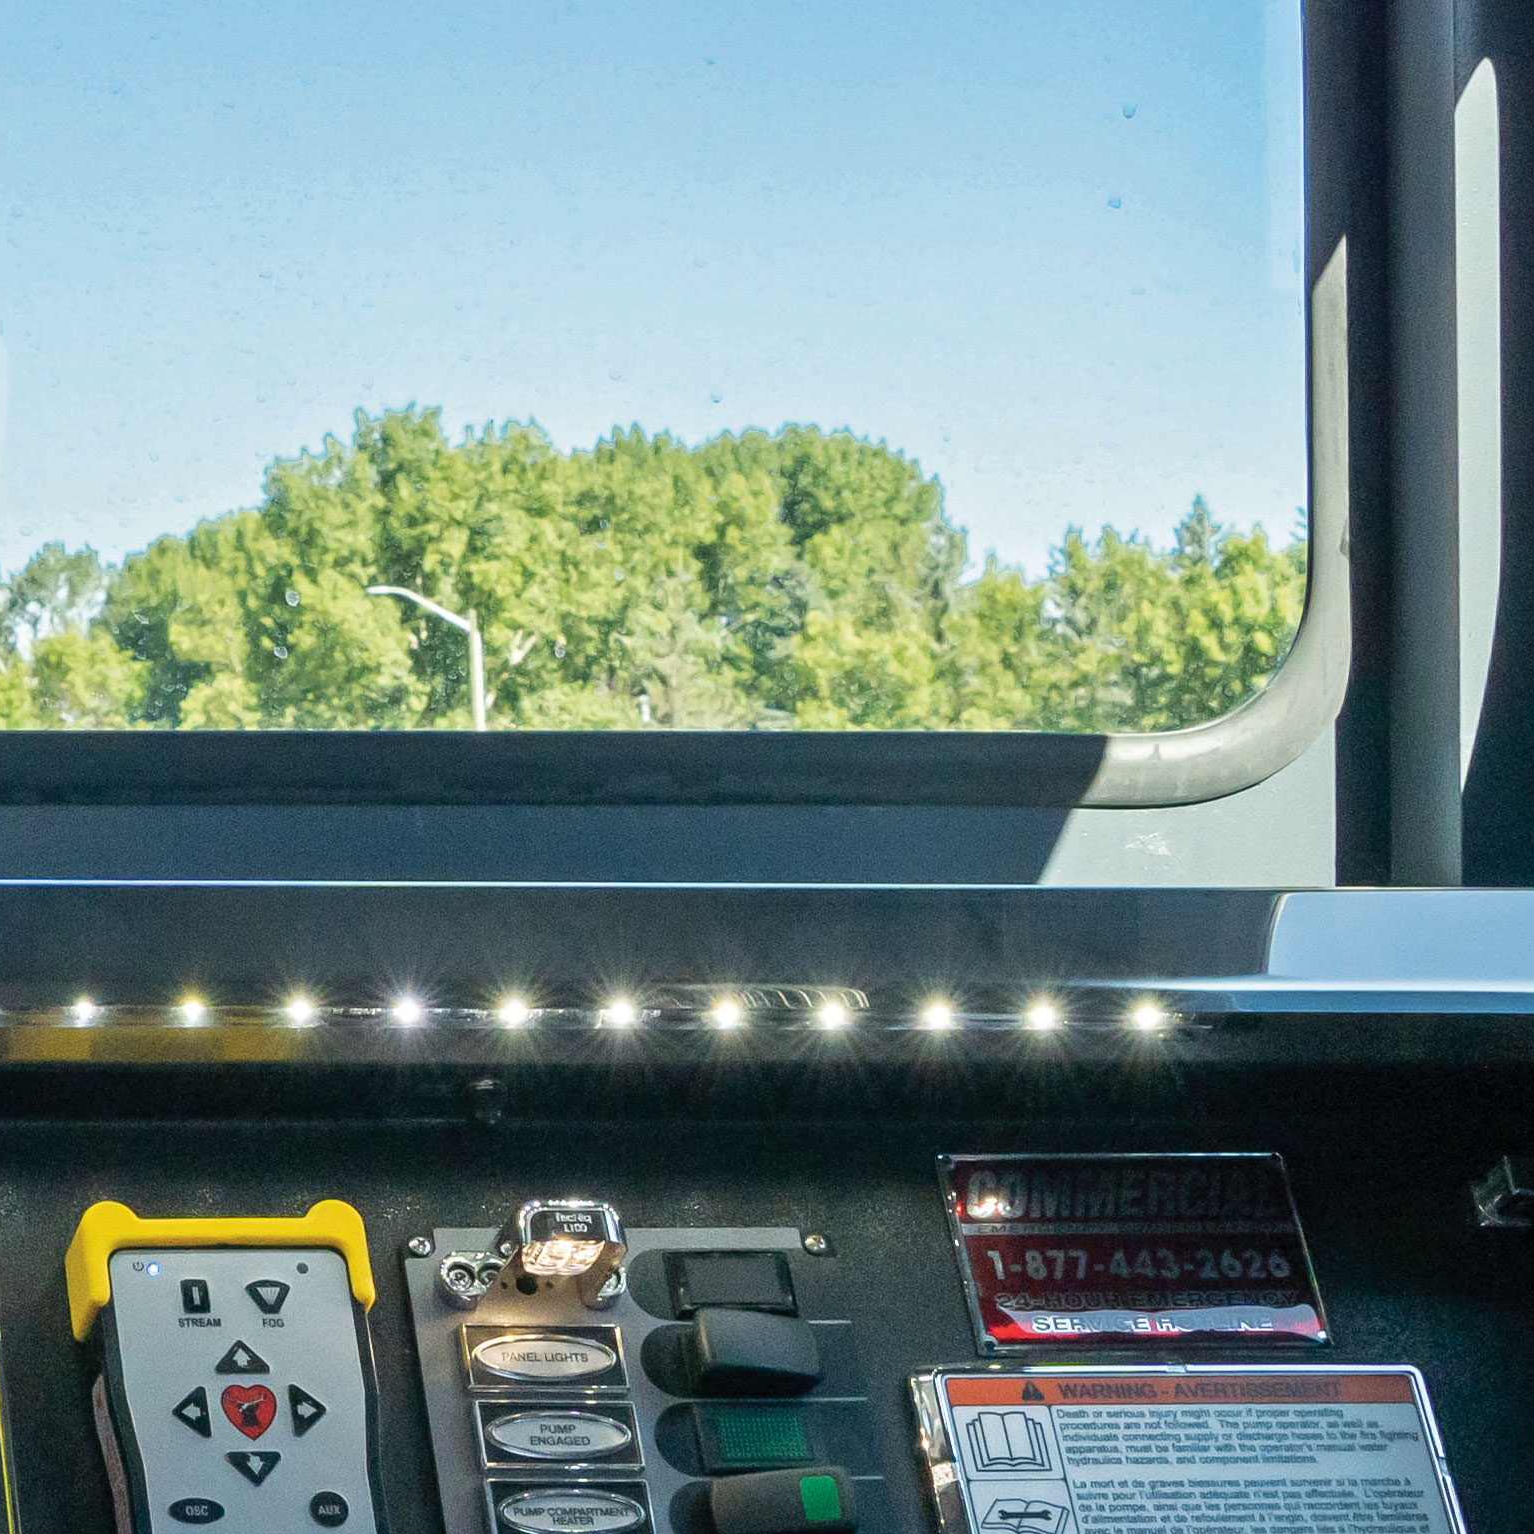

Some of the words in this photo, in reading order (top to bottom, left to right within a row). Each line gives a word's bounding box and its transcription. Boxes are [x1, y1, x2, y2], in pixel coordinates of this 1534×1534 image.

[966, 1170, 1279, 1219] COMMERCIAL
[987, 1249, 1291, 1280] 1-877-443-2626
[995, 1291, 1123, 1310] 24-HOUR
[1128, 1290, 1298, 1308] EMERGENCY
[178, 1318, 221, 1328] STREAM
[262, 1318, 284, 1328] FOG
[502, 1353, 542, 1362] PANEL
[544, 1353, 589, 1362] LIGHTS
[1057, 1382, 1158, 1398] WARNING
[1173, 1382, 1340, 1398] AVERTISSEMENT
[540, 1424, 576, 1434] PUMP
[530, 1435, 591, 1446] ENGAGED
[185, 1505, 209, 1516] OSC
[317, 1504, 341, 1516] AUX
[513, 1508, 545, 1517] PUMP
[547, 1507, 629, 1517] COMPARTMENT
[552, 1516, 594, 1526] HEATER
